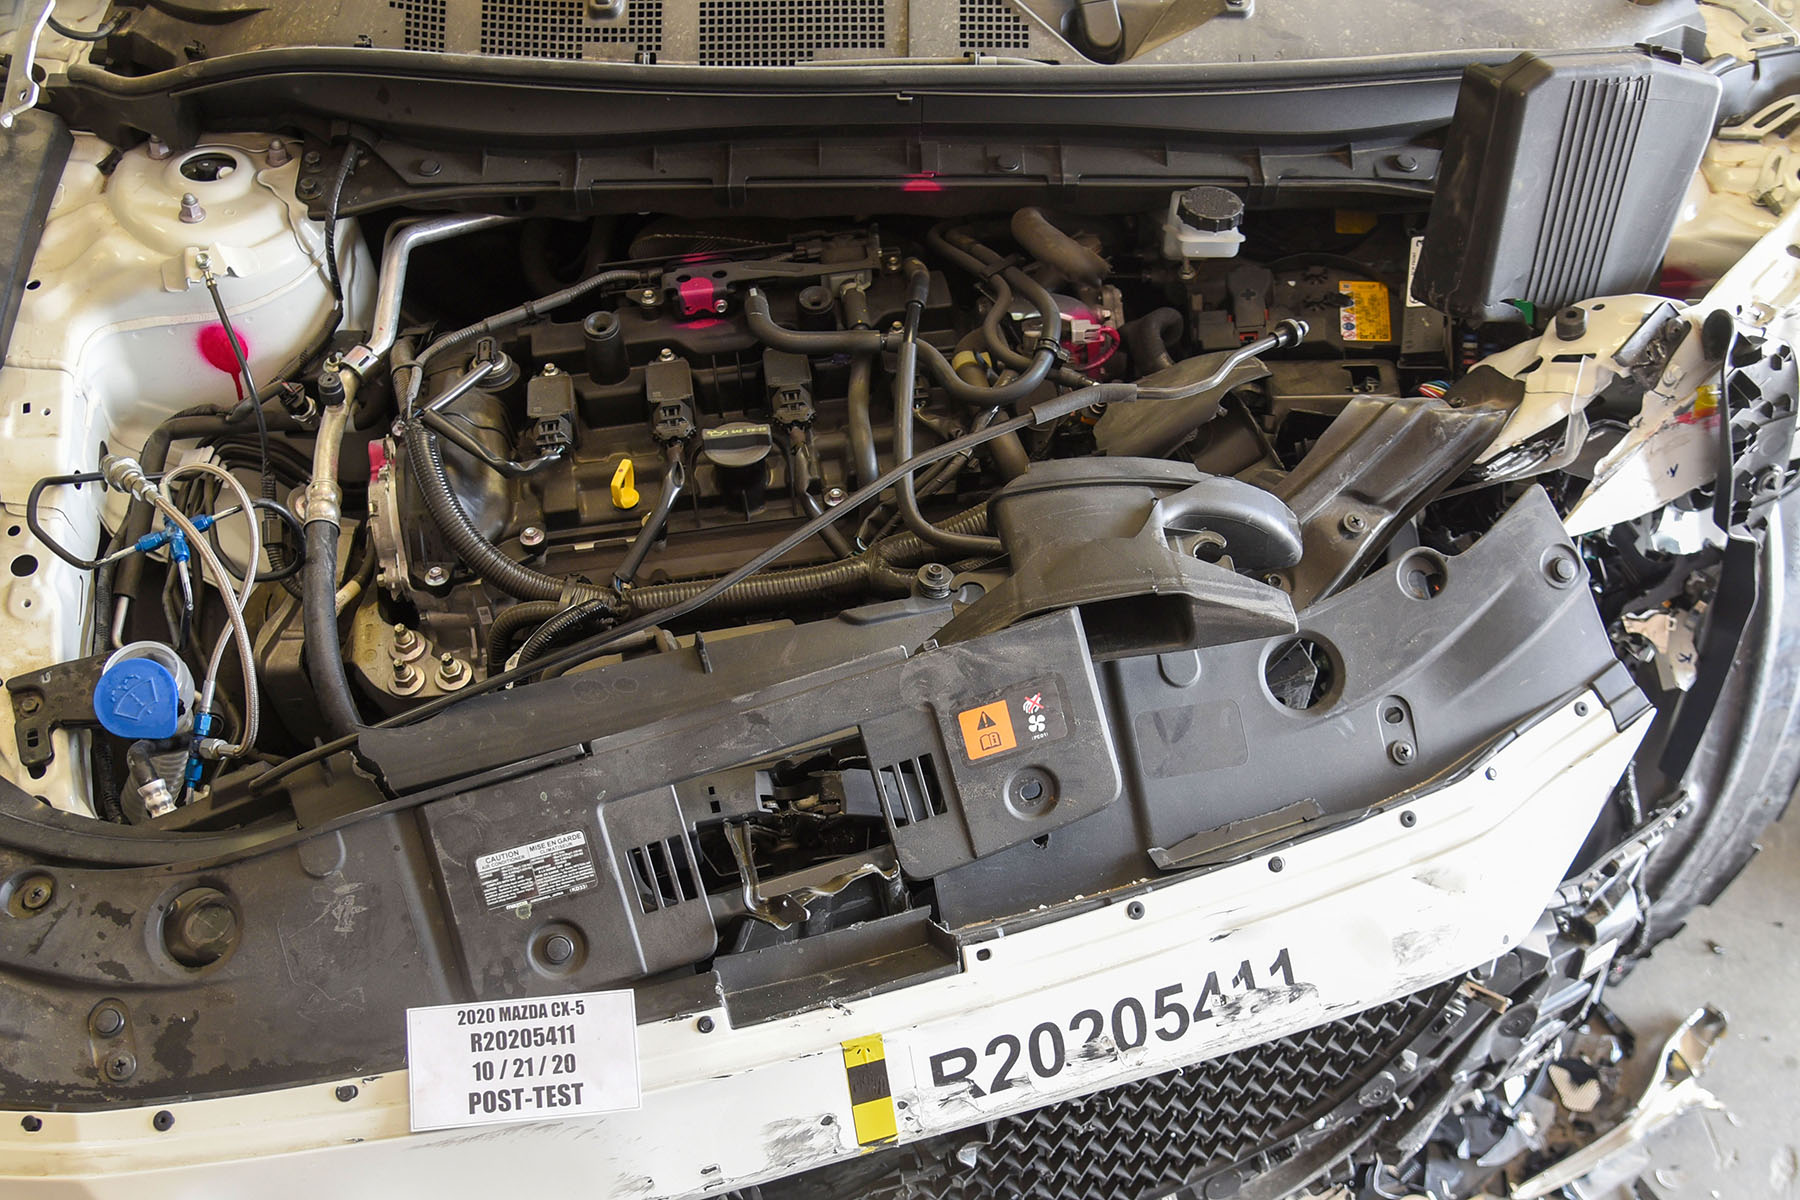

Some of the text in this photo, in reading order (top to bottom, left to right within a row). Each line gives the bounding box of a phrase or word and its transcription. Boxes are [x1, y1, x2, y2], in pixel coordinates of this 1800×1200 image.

[529, 833, 582, 852] MISE EN GARDE
[539, 842, 574, 855] CLIMATISEUR
[485, 850, 520, 864] CAUTION
[490, 855, 525, 868] CONDITIONER
[457, 1000, 585, 1026] 2020 MAZDA CX-5
[470, 1024, 576, 1053] R20205411
[468, 1082, 584, 1115] POST-TEST
